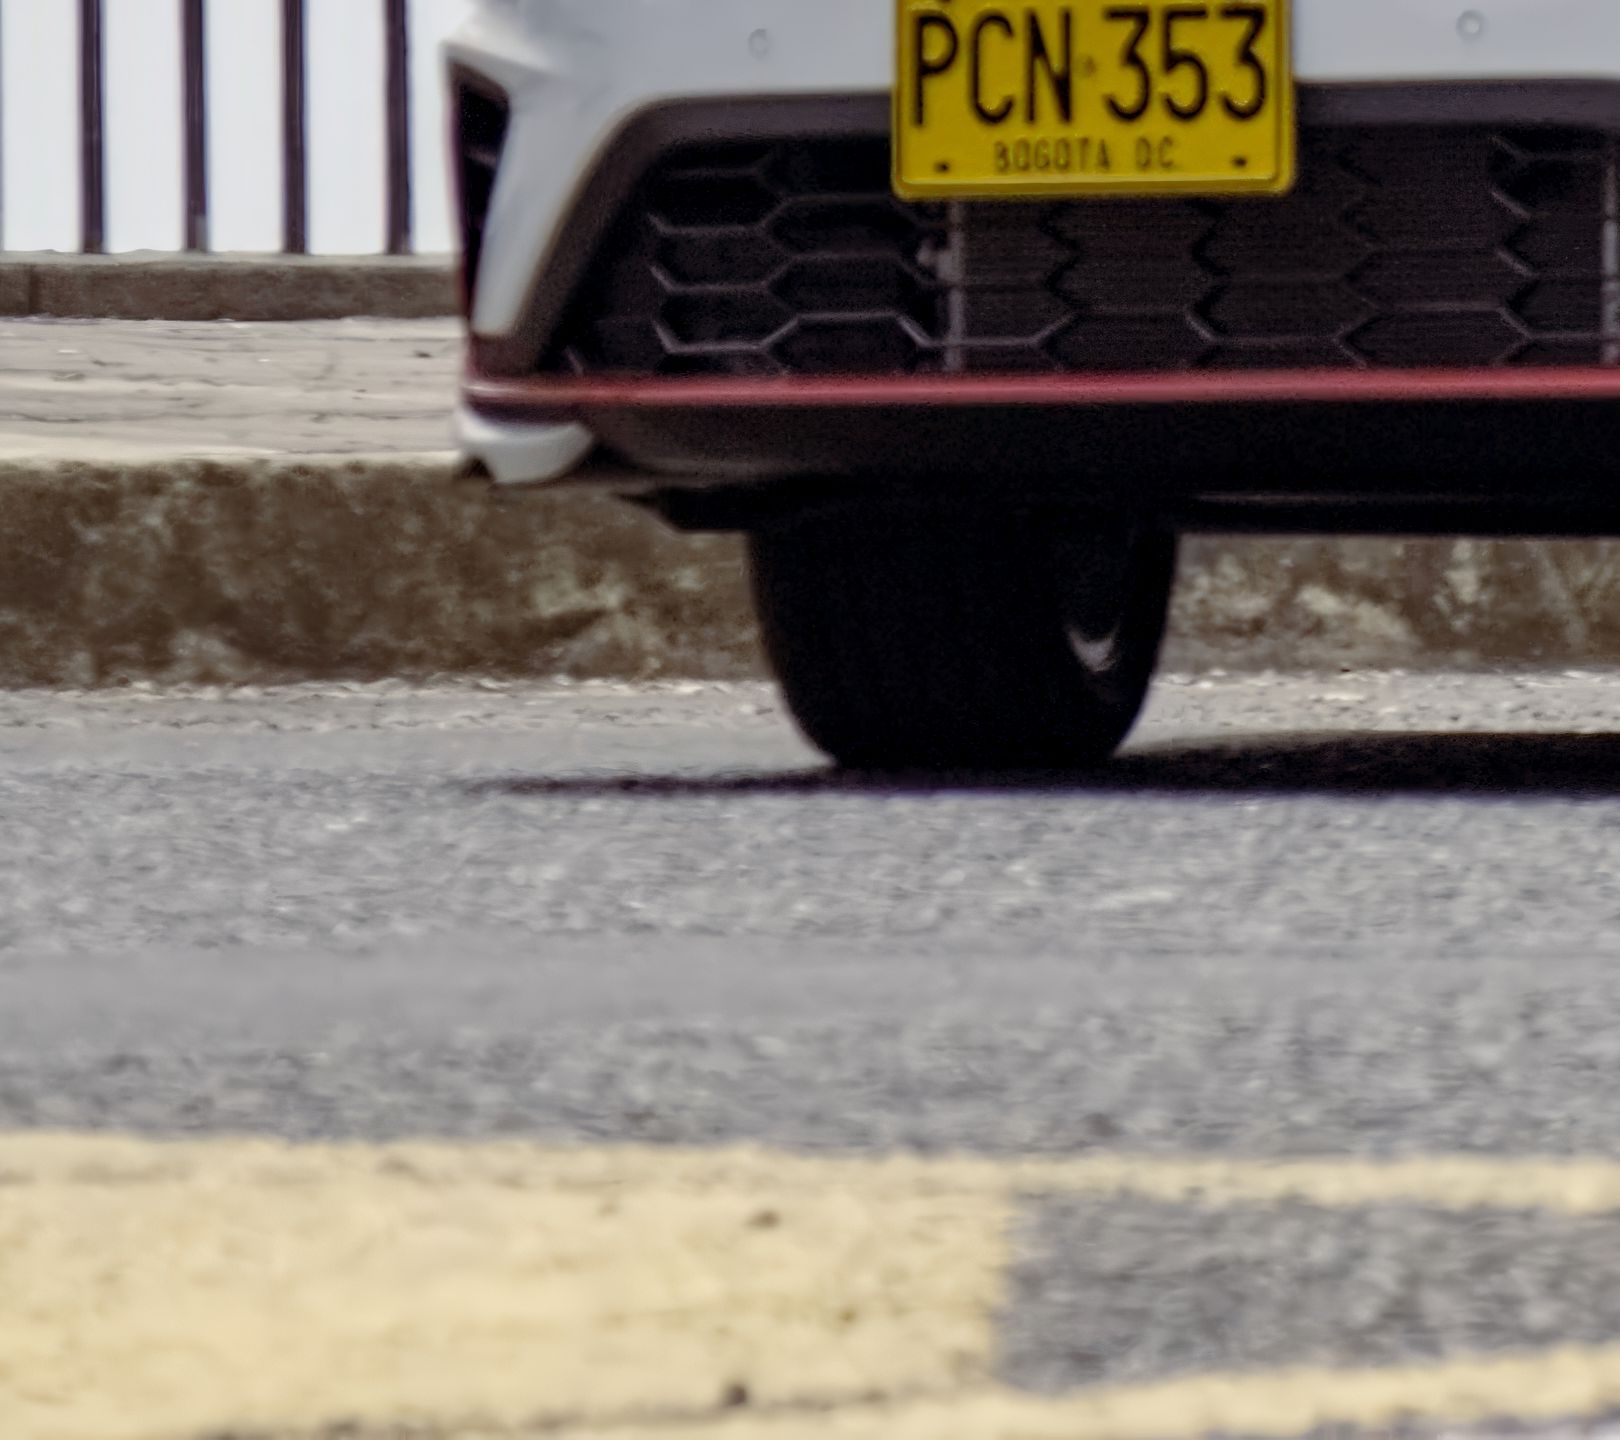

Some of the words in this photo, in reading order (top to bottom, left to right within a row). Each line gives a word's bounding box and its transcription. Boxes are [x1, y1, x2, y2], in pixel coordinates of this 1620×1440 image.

[912, 8, 1073, 124] PCN
[1104, 3, 1267, 120] 353
[994, 136, 1111, 173] BOGOTA
